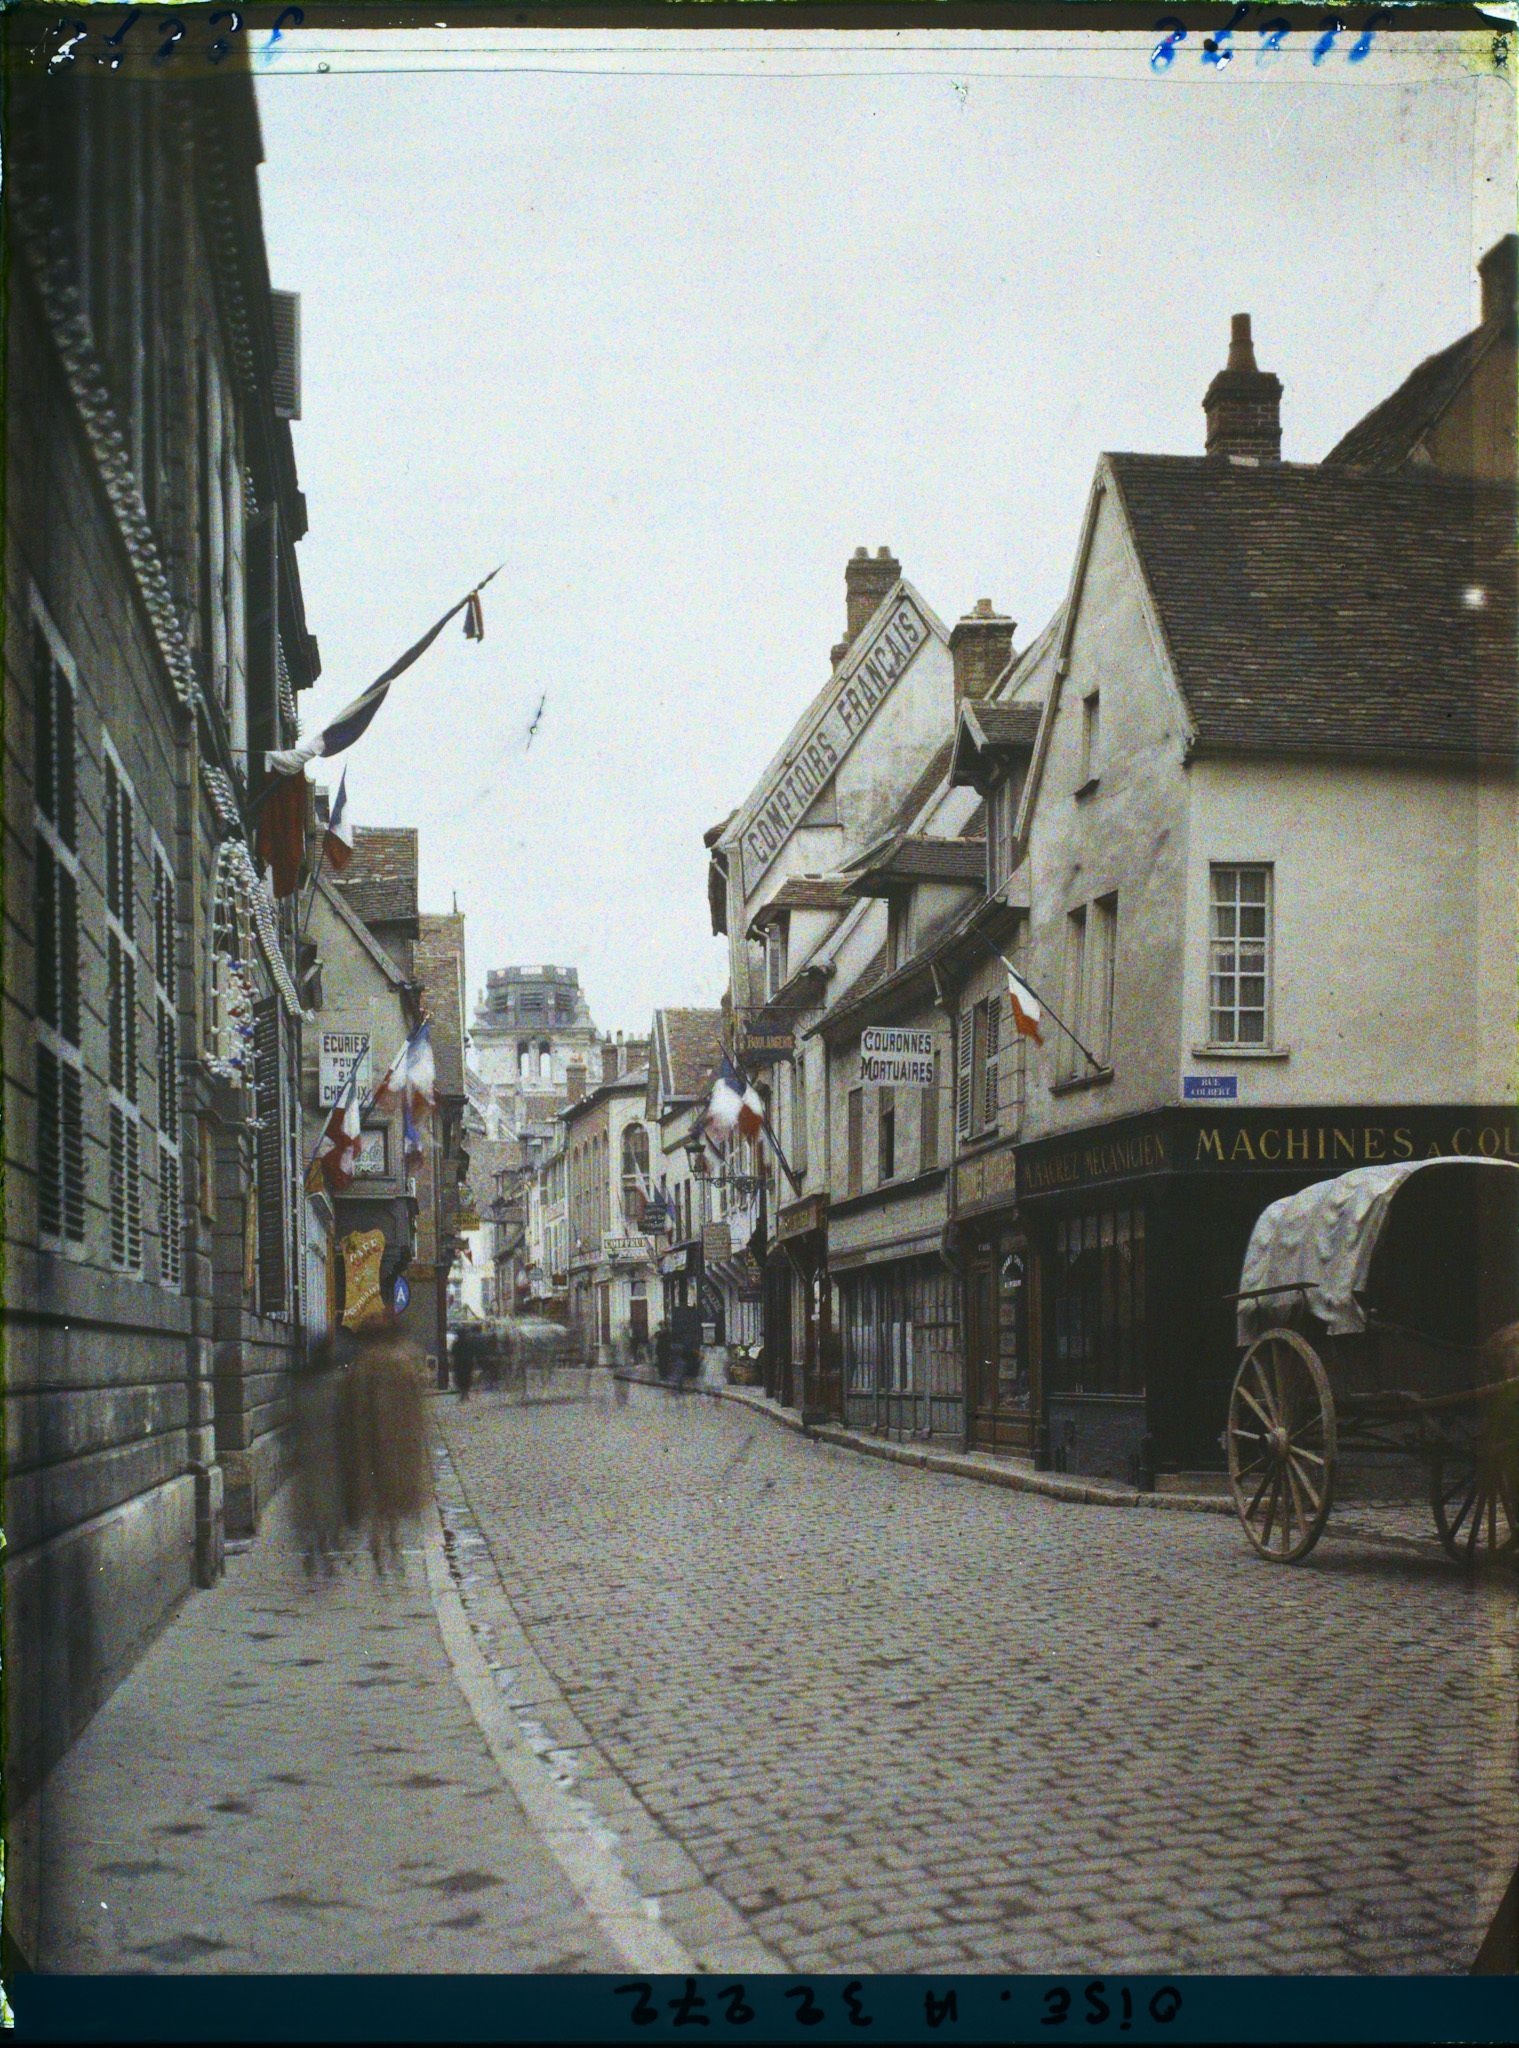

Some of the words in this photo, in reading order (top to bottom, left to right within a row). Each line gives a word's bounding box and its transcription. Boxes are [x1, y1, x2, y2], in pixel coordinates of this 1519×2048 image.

[748, 731, 839, 864] COMPTOIRS
[863, 1030, 933, 1055] COURONNES
[1191, 1087, 1232, 1097] COLBERT
[1201, 1078, 1220, 1087] RUE
[1195, 1127, 1414, 1161] MACHINES
[613, 1977, 755, 2027] 272
[784, 1980, 873, 2027] 32
[924, 1990, 959, 2028] A
